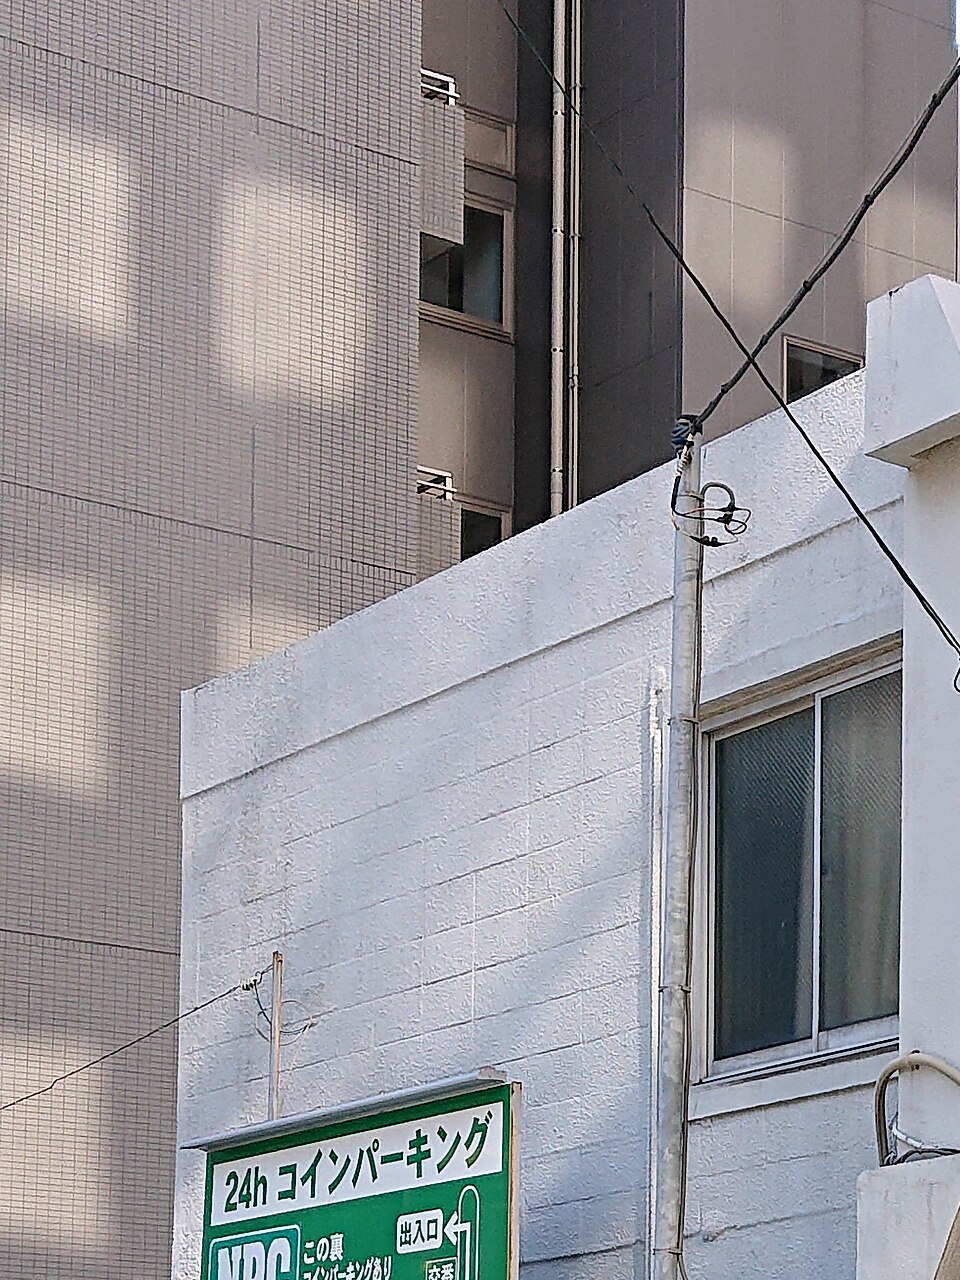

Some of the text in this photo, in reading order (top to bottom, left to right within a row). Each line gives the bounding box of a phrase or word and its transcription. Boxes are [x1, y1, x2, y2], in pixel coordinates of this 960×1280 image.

[224, 1111, 493, 1213] 24h コインパーキング
[303, 1232, 344, 1265] この裏
[400, 1218, 439, 1248] 出入口
